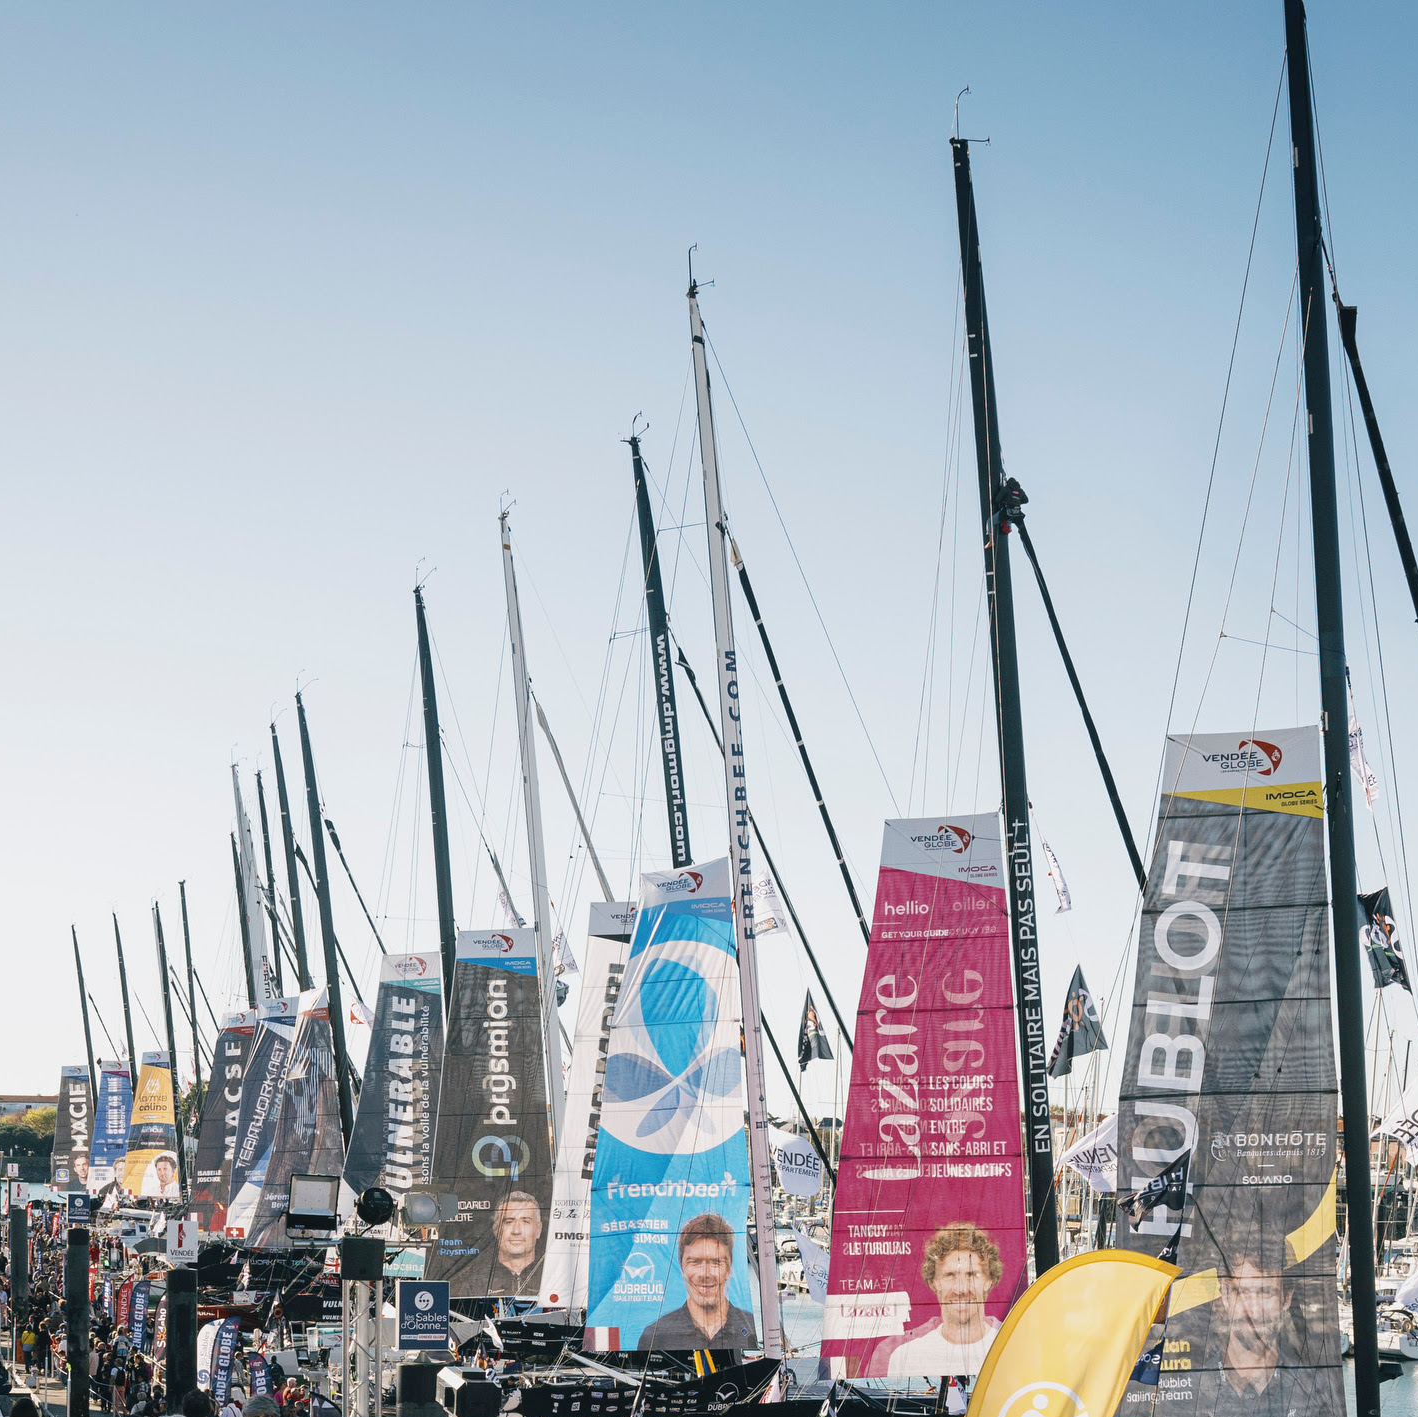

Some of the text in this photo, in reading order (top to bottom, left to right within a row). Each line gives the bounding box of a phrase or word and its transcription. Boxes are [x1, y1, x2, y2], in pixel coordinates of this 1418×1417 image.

[656, 634, 687, 862] www.dmgmori.com
[1202, 750, 1258, 764] VENDÉE
[1220, 758, 1264, 769] GLOBE
[725, 650, 756, 940] FRENCHBEE.COM
[1265, 789, 1317, 801] IMOCA
[910, 833, 953, 843] VENDÉE
[924, 840, 958, 848] GLOBE
[958, 865, 998, 873] IMOCA
[656, 878, 688, 888] VENDÉE
[665, 883, 692, 892] GLOBE
[691, 901, 726, 910] IMOCA
[884, 901, 929, 916] hellio
[881, 929, 949, 939] GET YOUR GUIDE
[473, 938, 501, 946] VENDÉE
[1015, 833, 1050, 1154] EN SOLITAIRE MAIS PAS SEUL
[421, 1005, 430, 1078] vulnérabilité
[1129, 839, 1232, 1238] HUBLOT
[484, 979, 517, 1125] prysmian
[929, 1075, 994, 1090] LES COLOCS
[422, 1091, 430, 1101] de
[929, 1097, 993, 1112] SOLIDAIRES
[422, 1105, 430, 1140] voile
[930, 1119, 966, 1134] ENTRE
[932, 1141, 1007, 1156] SANS-ABRI ET
[1236, 1147, 1326, 1159] Banquiers depuis 1815
[932, 1163, 1012, 1178] JEUNES ACTIFS
[601, 1219, 669, 1233] SÉBASTIEN
[848, 1224, 887, 1238] TANGUY
[170, 1249, 195, 1257] VENDÉE
[440, 1247, 480, 1257] Prysmian
[840, 1279, 874, 1291] TEAM
[120, 1287, 128, 1320] VENDÉE
[136, 1292, 145, 1320] GLOBE
[404, 1313, 448, 1322] les Sables
[218, 1331, 233, 1367] GLOBE
[1126, 1389, 1193, 1404] Sailing Team
